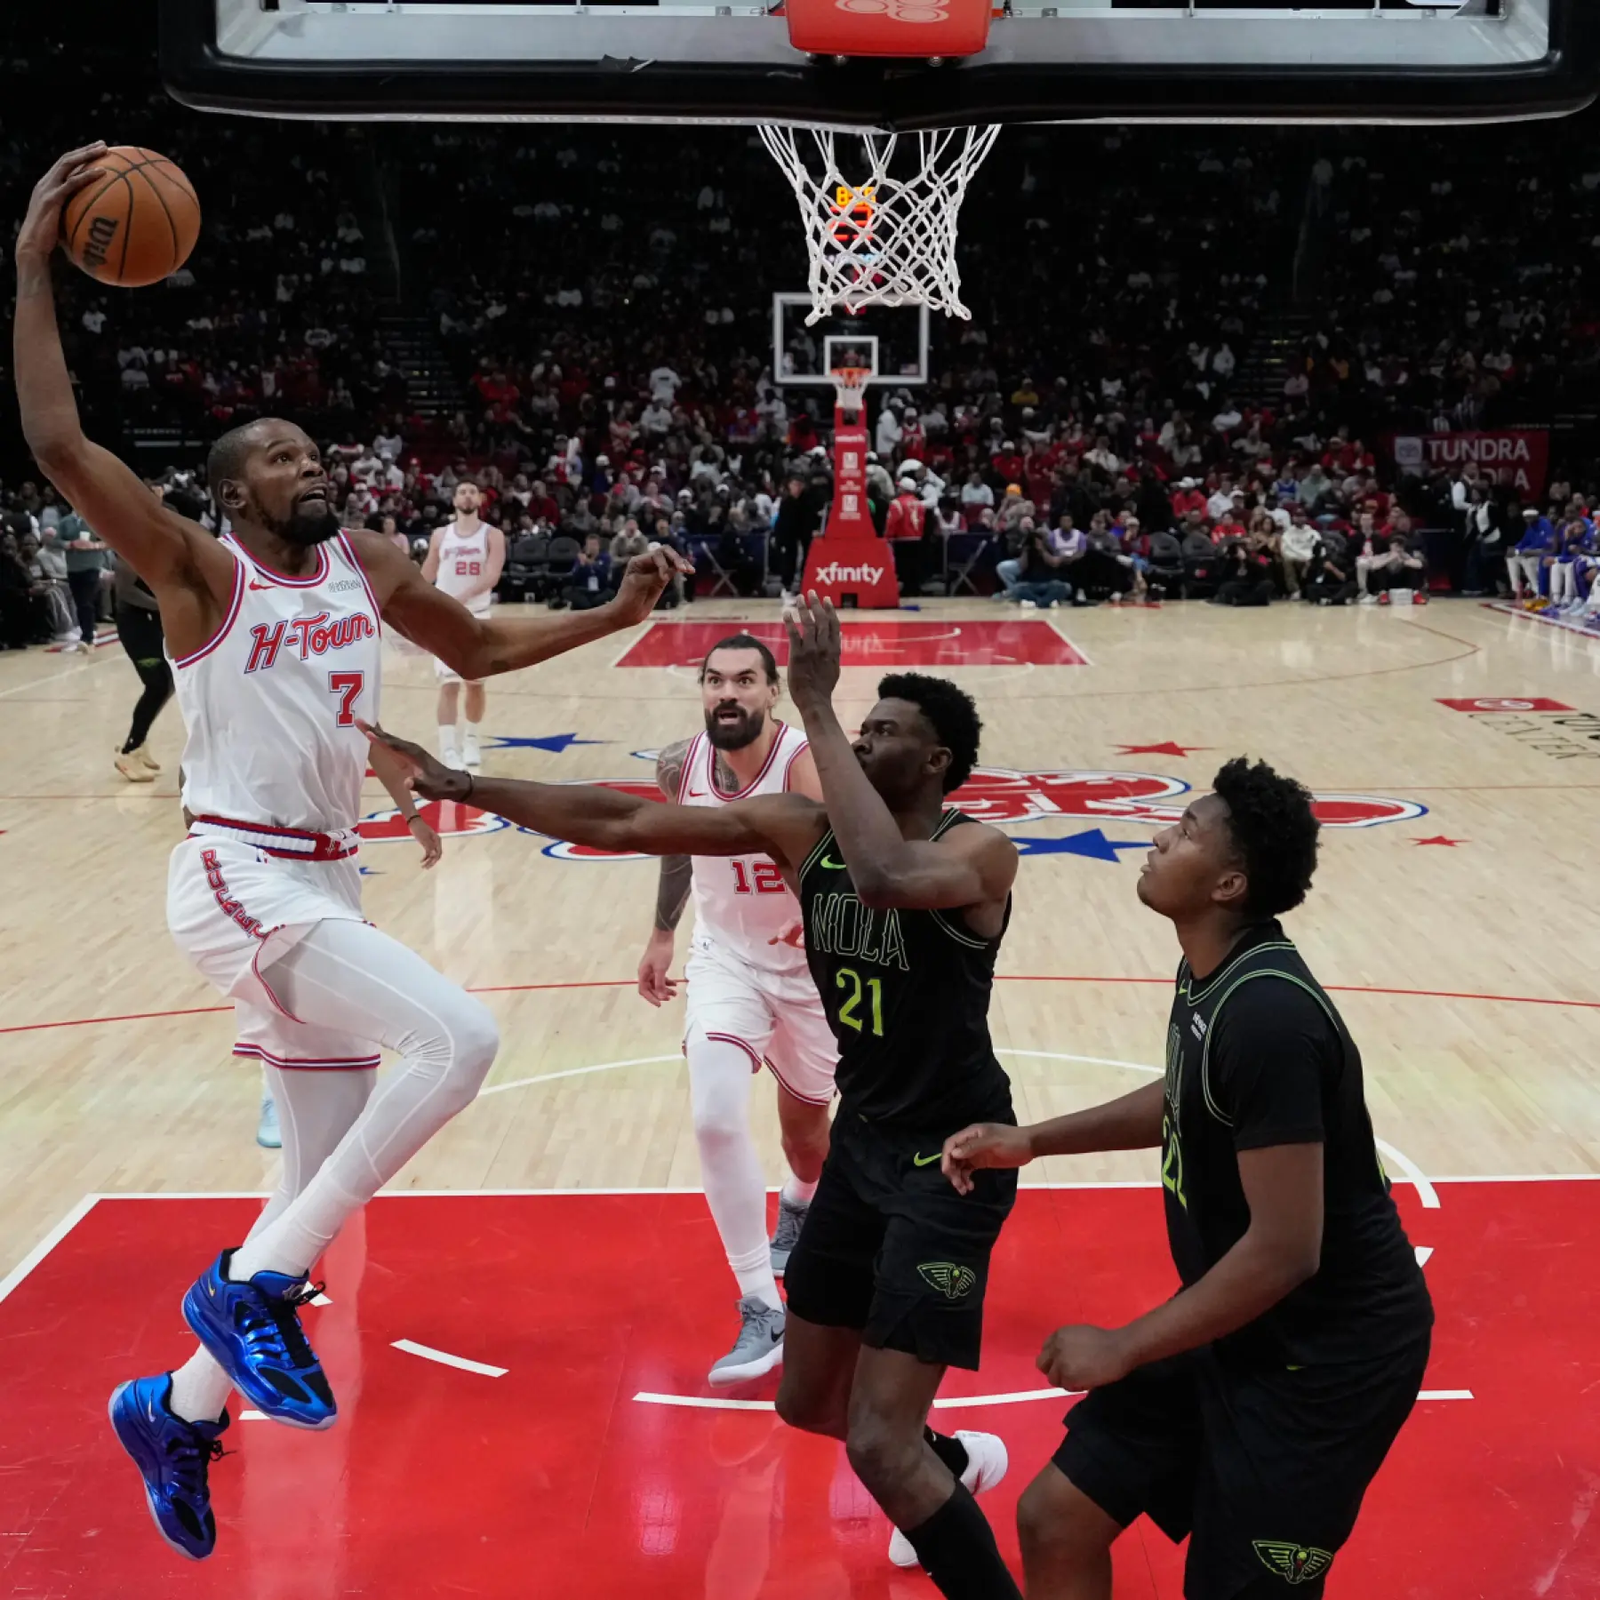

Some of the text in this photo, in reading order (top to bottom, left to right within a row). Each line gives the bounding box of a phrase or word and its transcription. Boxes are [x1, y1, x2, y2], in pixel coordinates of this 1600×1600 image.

[1427, 438, 1530, 462] TUNDRA
[455, 561, 481, 576] 28
[815, 561, 884, 586] xfinity
[244, 611, 375, 674] H-Town
[328, 671, 364, 728] 7
[730, 859, 788, 895] 12
[812, 893, 910, 971] NOLA
[836, 968, 884, 1036] 21
